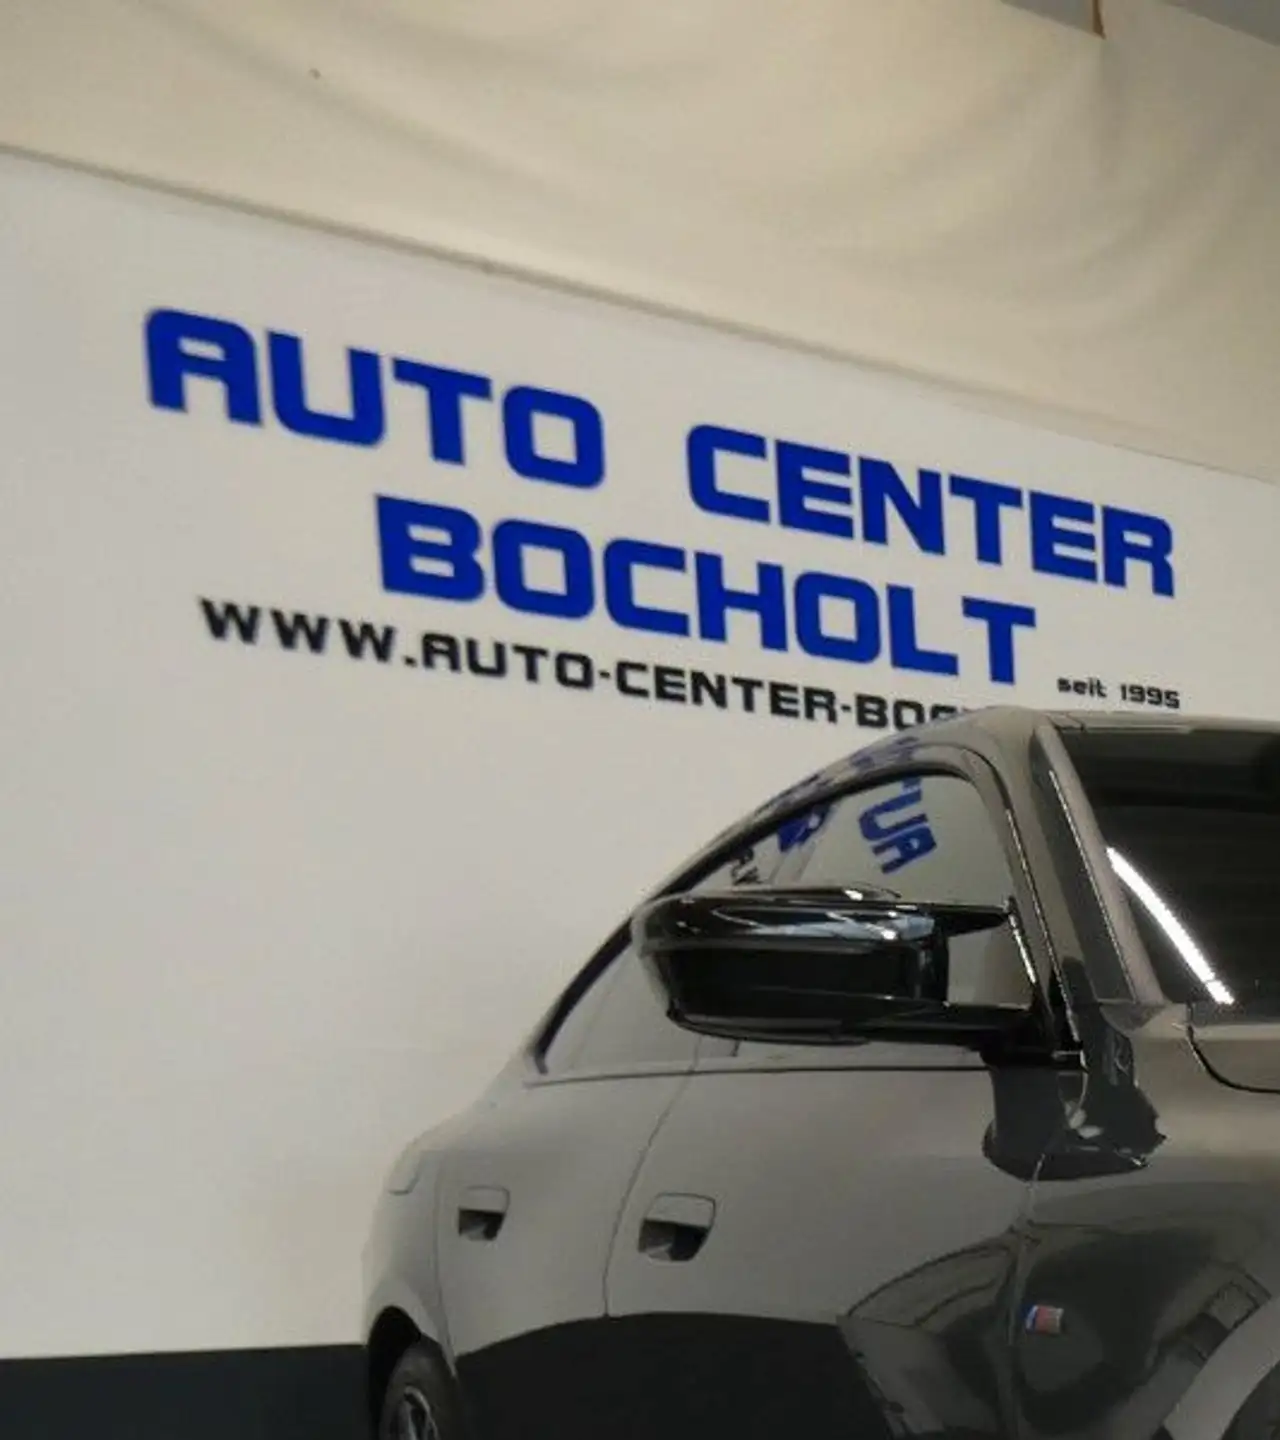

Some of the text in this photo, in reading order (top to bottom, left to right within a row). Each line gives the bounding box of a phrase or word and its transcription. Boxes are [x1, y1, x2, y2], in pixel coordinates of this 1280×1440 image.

[145, 308, 1174, 597] AUTO CENTER
[376, 496, 1037, 685] BOCHOLT
[1057, 676, 1180, 709] seit 1995
